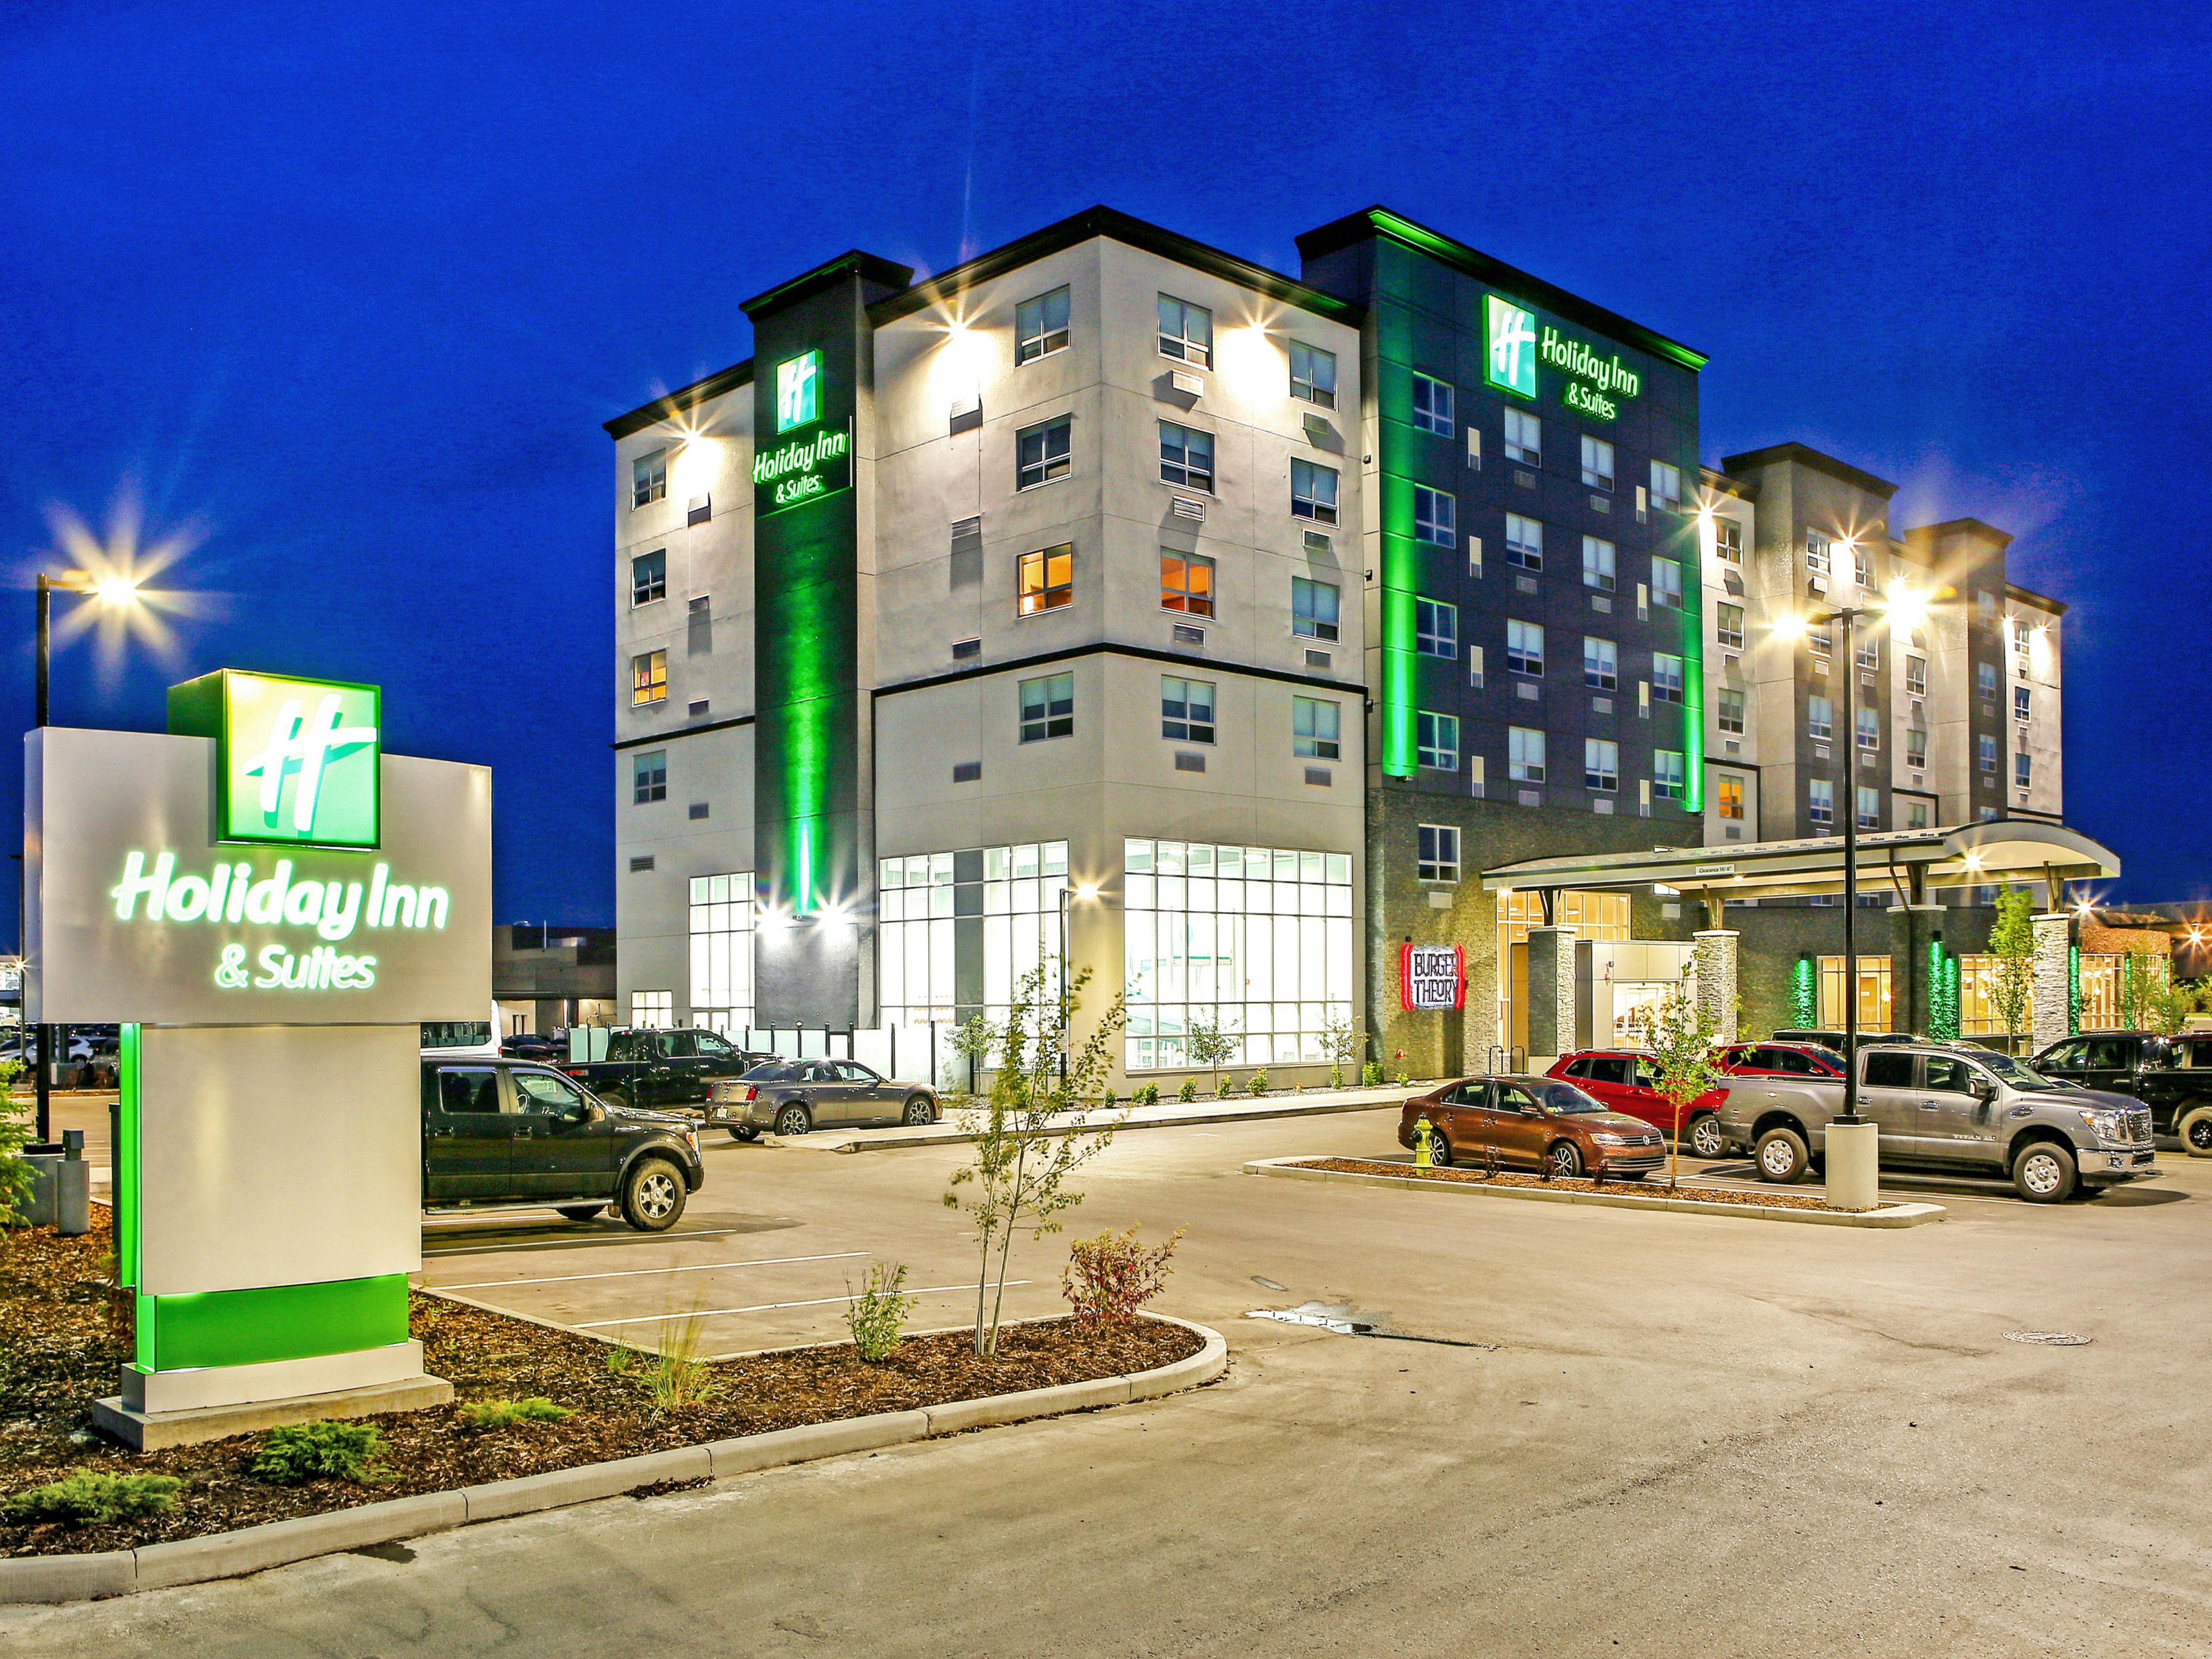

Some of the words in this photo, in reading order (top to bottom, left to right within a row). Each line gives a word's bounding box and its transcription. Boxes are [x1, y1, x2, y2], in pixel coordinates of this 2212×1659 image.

[1541, 325, 1609, 390] Holiday
[1611, 356, 1639, 397] Inn
[1568, 382, 1578, 406] &
[1580, 387, 1615, 420] Suites
[753, 442, 815, 483] Holiday
[816, 430, 847, 461] Inn
[775, 483, 787, 504] &
[785, 474, 821, 500] Suites
[111, 851, 363, 941] Holiday
[366, 862, 450, 930] Inn
[215, 942, 249, 989] &
[254, 943, 378, 990] Suites
[1413, 953, 1458, 977] BURGER
[1413, 979, 1459, 1003] THEORY
